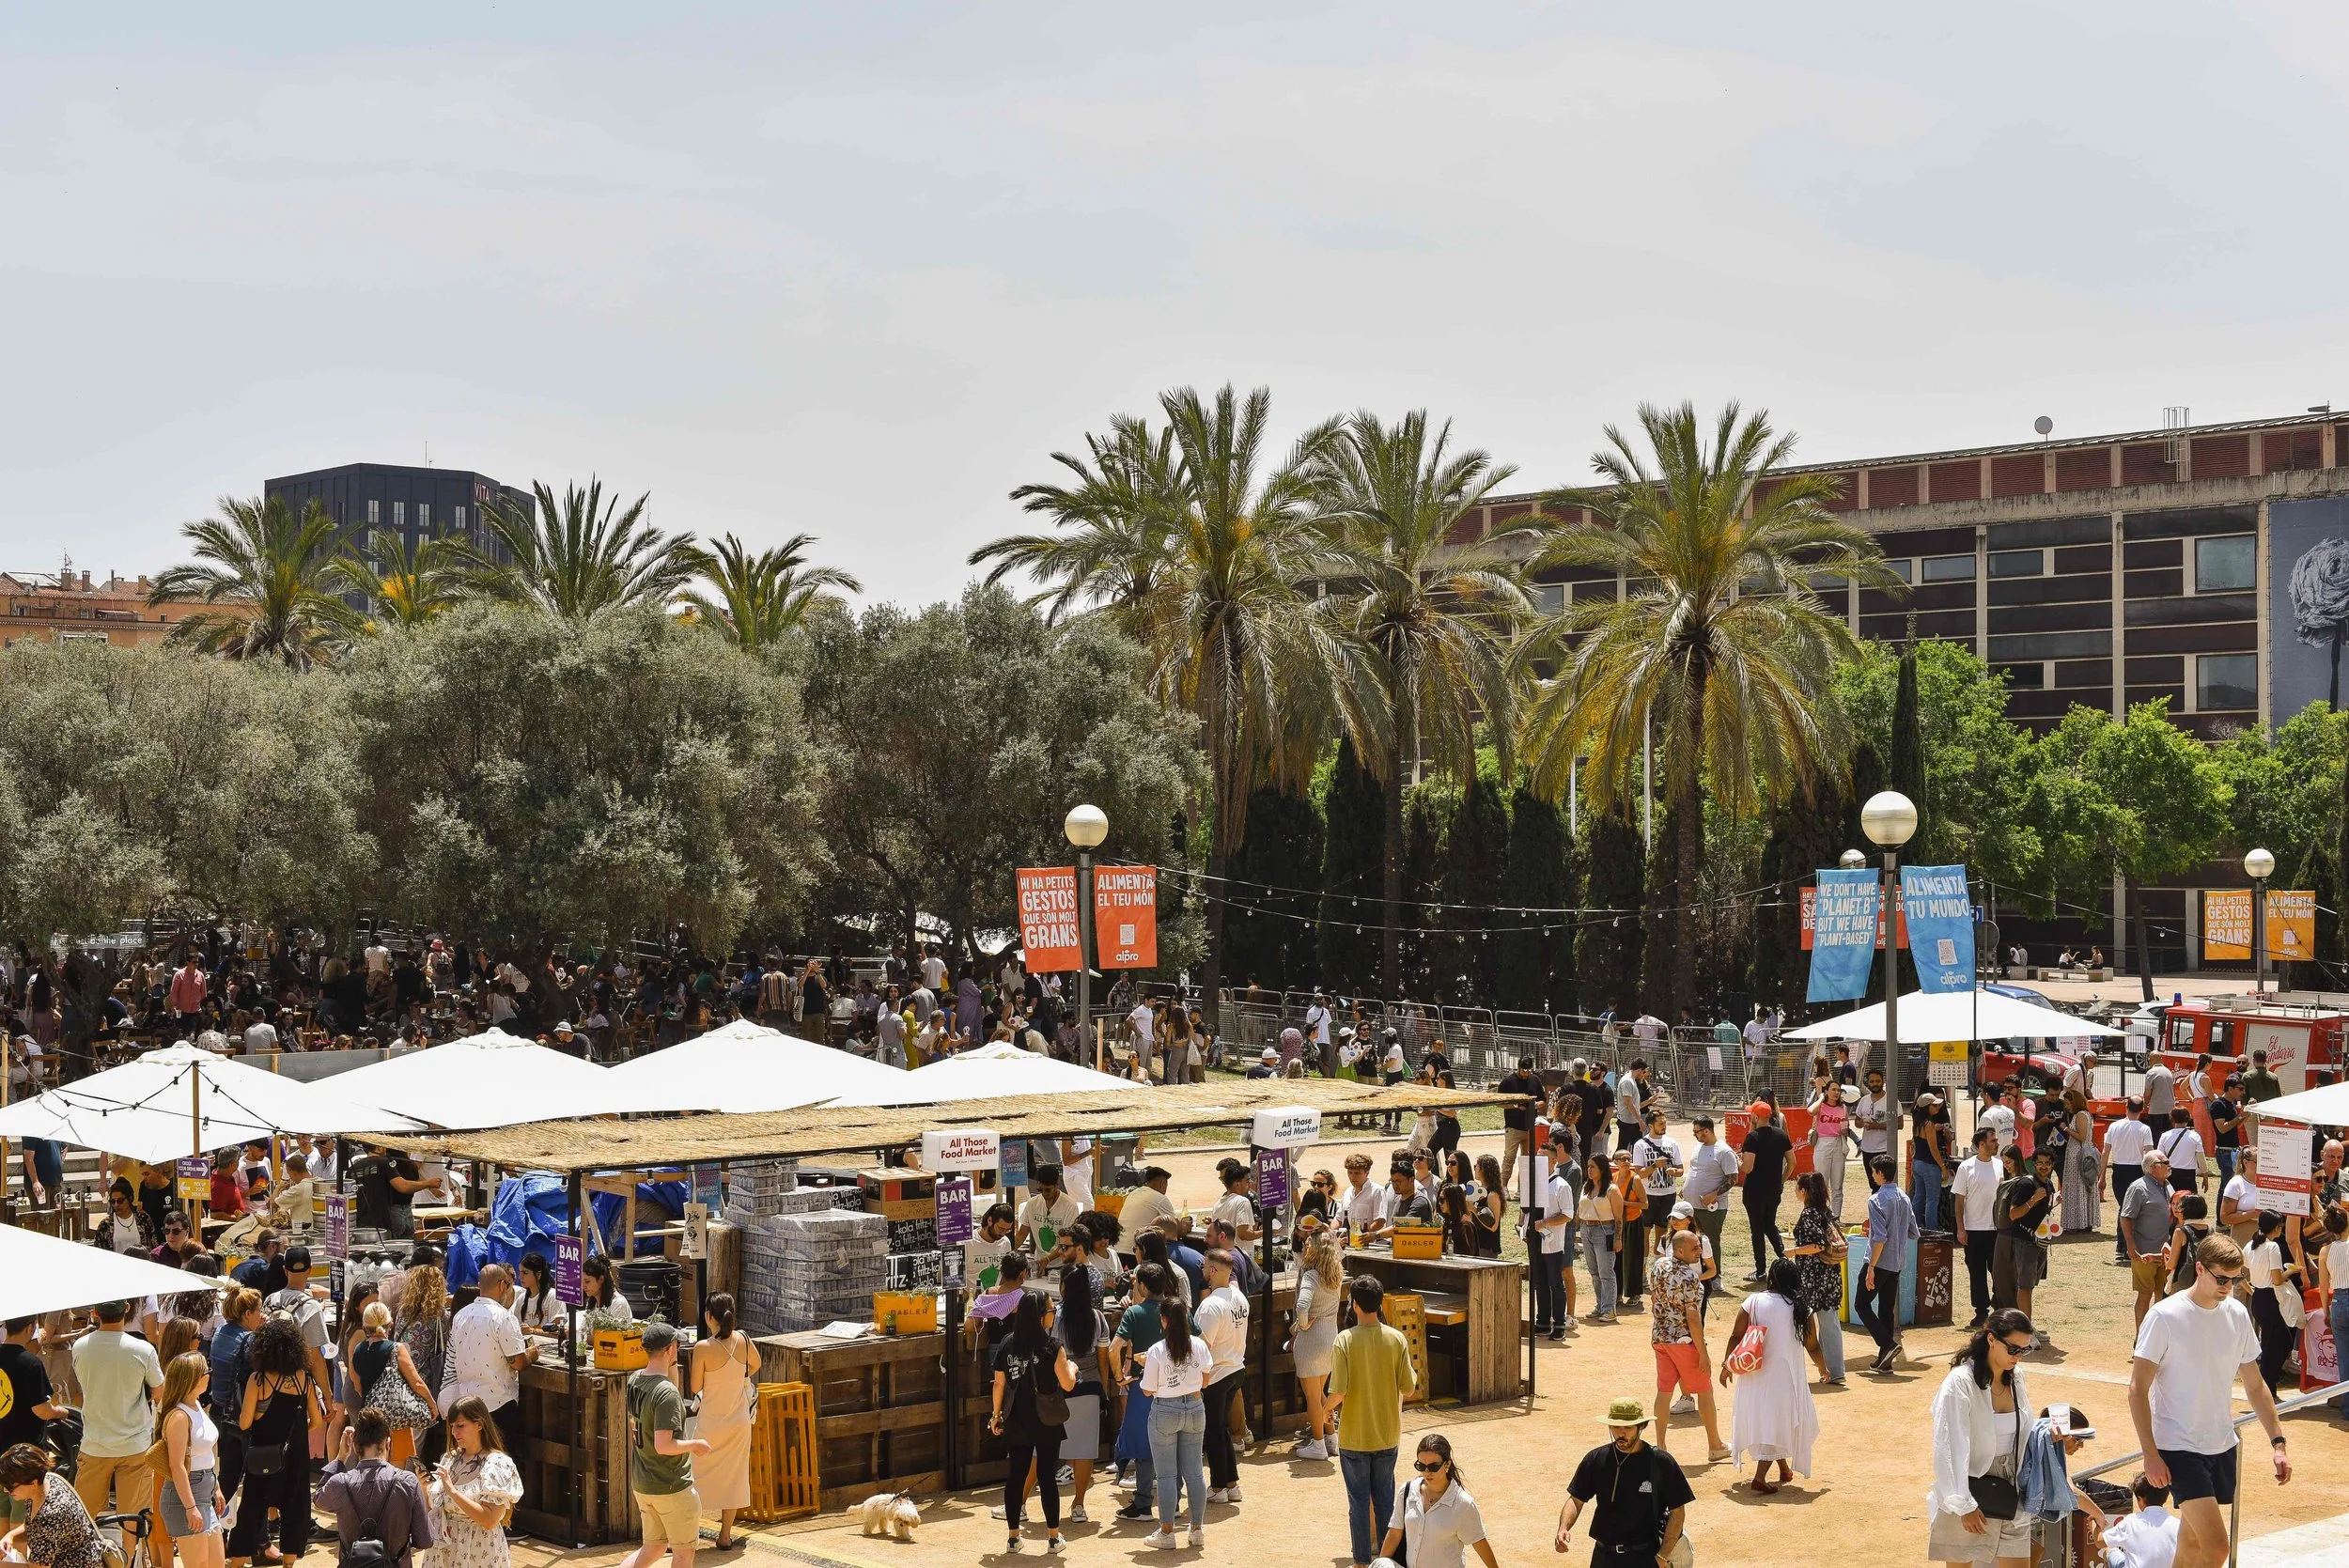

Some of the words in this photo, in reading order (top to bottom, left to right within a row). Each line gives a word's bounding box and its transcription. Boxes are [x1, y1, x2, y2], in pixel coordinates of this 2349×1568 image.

[1020, 877, 1029, 890] HI
[1032, 877, 1043, 889] HA
[1046, 875, 1074, 888] PETITS
[1097, 874, 1154, 890] ALIMENTA
[1820, 885, 1832, 895] WE
[1834, 883, 1855, 896] DON'T
[1858, 882, 1876, 895] HAVE
[1906, 875, 1966, 896] ALIMENTA
[1022, 890, 1075, 911] GESTOS
[1098, 894, 1110, 906] EL
[1113, 893, 1131, 906] TEU
[1134, 887, 1153, 906] MÓN
[2227, 896, 2250, 905] PETITS
[2269, 897, 2312, 907] ALIMENTA
[1907, 900, 1926, 919] TU
[1929, 898, 1969, 918] MUNDO
[2208, 906, 2250, 919] GESTOS
[2269, 909, 2277, 918] EL
[2280, 909, 2293, 918] TEU
[2296, 906, 2312, 918] MÓN
[1023, 914, 1040, 924] QUE
[1042, 911, 1057, 924] SÓN
[1059, 911, 1075, 923] MOLT
[1818, 917, 1832, 932] BUT
[1836, 917, 1850, 931] WE
[1852, 915, 1874, 931] HAVE
[120, 935, 142, 945] place
[1024, 924, 1078, 949] GRANS
[1817, 931, 1873, 946] "PLANT-BASED"
[2208, 929, 2250, 944] GRANS
[1116, 950, 1139, 964] alpro
[1940, 971, 1967, 988] alpro
[2268, 1035, 2278, 1051] El
[2266, 1045, 2296, 1063] andarra
[1282, 1119, 1291, 1128] All
[1293, 1118, 1312, 1126] Those
[1274, 1129, 1292, 1138] Food
[1294, 1125, 1318, 1135] Market
[949, 1138, 961, 1148] All
[964, 1137, 988, 1147] Those
[941, 1148, 962, 1159] Food
[965, 1146, 996, 1157] Market
[1262, 1157, 1283, 1172] BAR
[940, 1189, 967, 1204] BAR
[329, 1205, 344, 1219] BAR
[903, 1230, 931, 1245] fritz-kola
[559, 1244, 579, 1262] BAR
